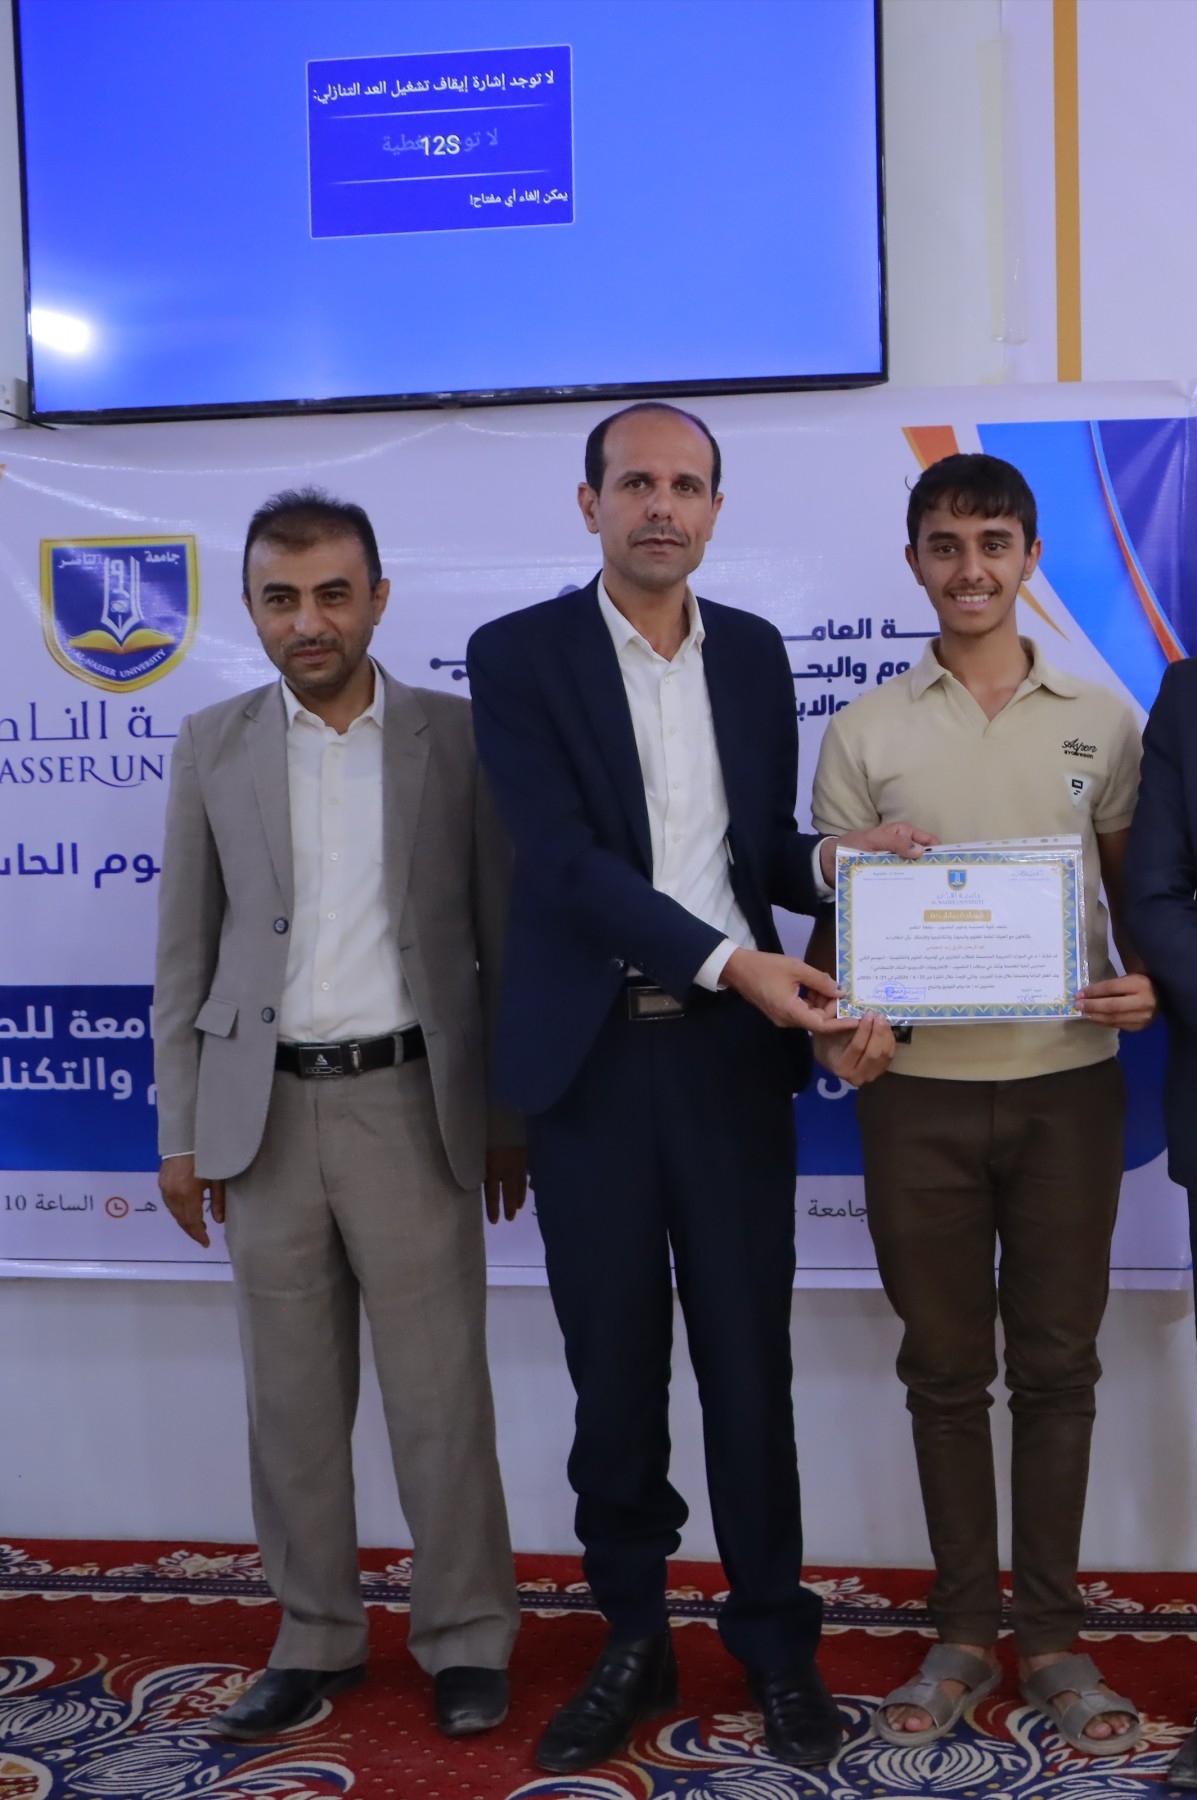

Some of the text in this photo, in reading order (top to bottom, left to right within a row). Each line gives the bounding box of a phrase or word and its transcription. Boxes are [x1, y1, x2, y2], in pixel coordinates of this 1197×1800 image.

[433, 75, 468, 93] إيقاف
[473, 73, 506, 91] إشارة
[510, 73, 542, 88] توجد
[544, 69, 555, 84] لا
[364, 80, 387, 95] العد
[391, 80, 430, 98] تشغيل
[421, 134, 460, 156] 12S
[519, 189, 540, 204] إلغاء
[543, 189, 568, 204] يمكن
[144, 550, 180, 565] جامعة
[783, 618, 872, 641] العام
[119, 649, 166, 678] UNIVERSITY
[793, 656, 867, 684] والبح
[0, 755, 142, 787] ASSER
[0, 1056, 133, 1101] والتكنل
[5, 1194, 95, 1213] الساعة 10
[808, 1199, 868, 1223] جامعة
